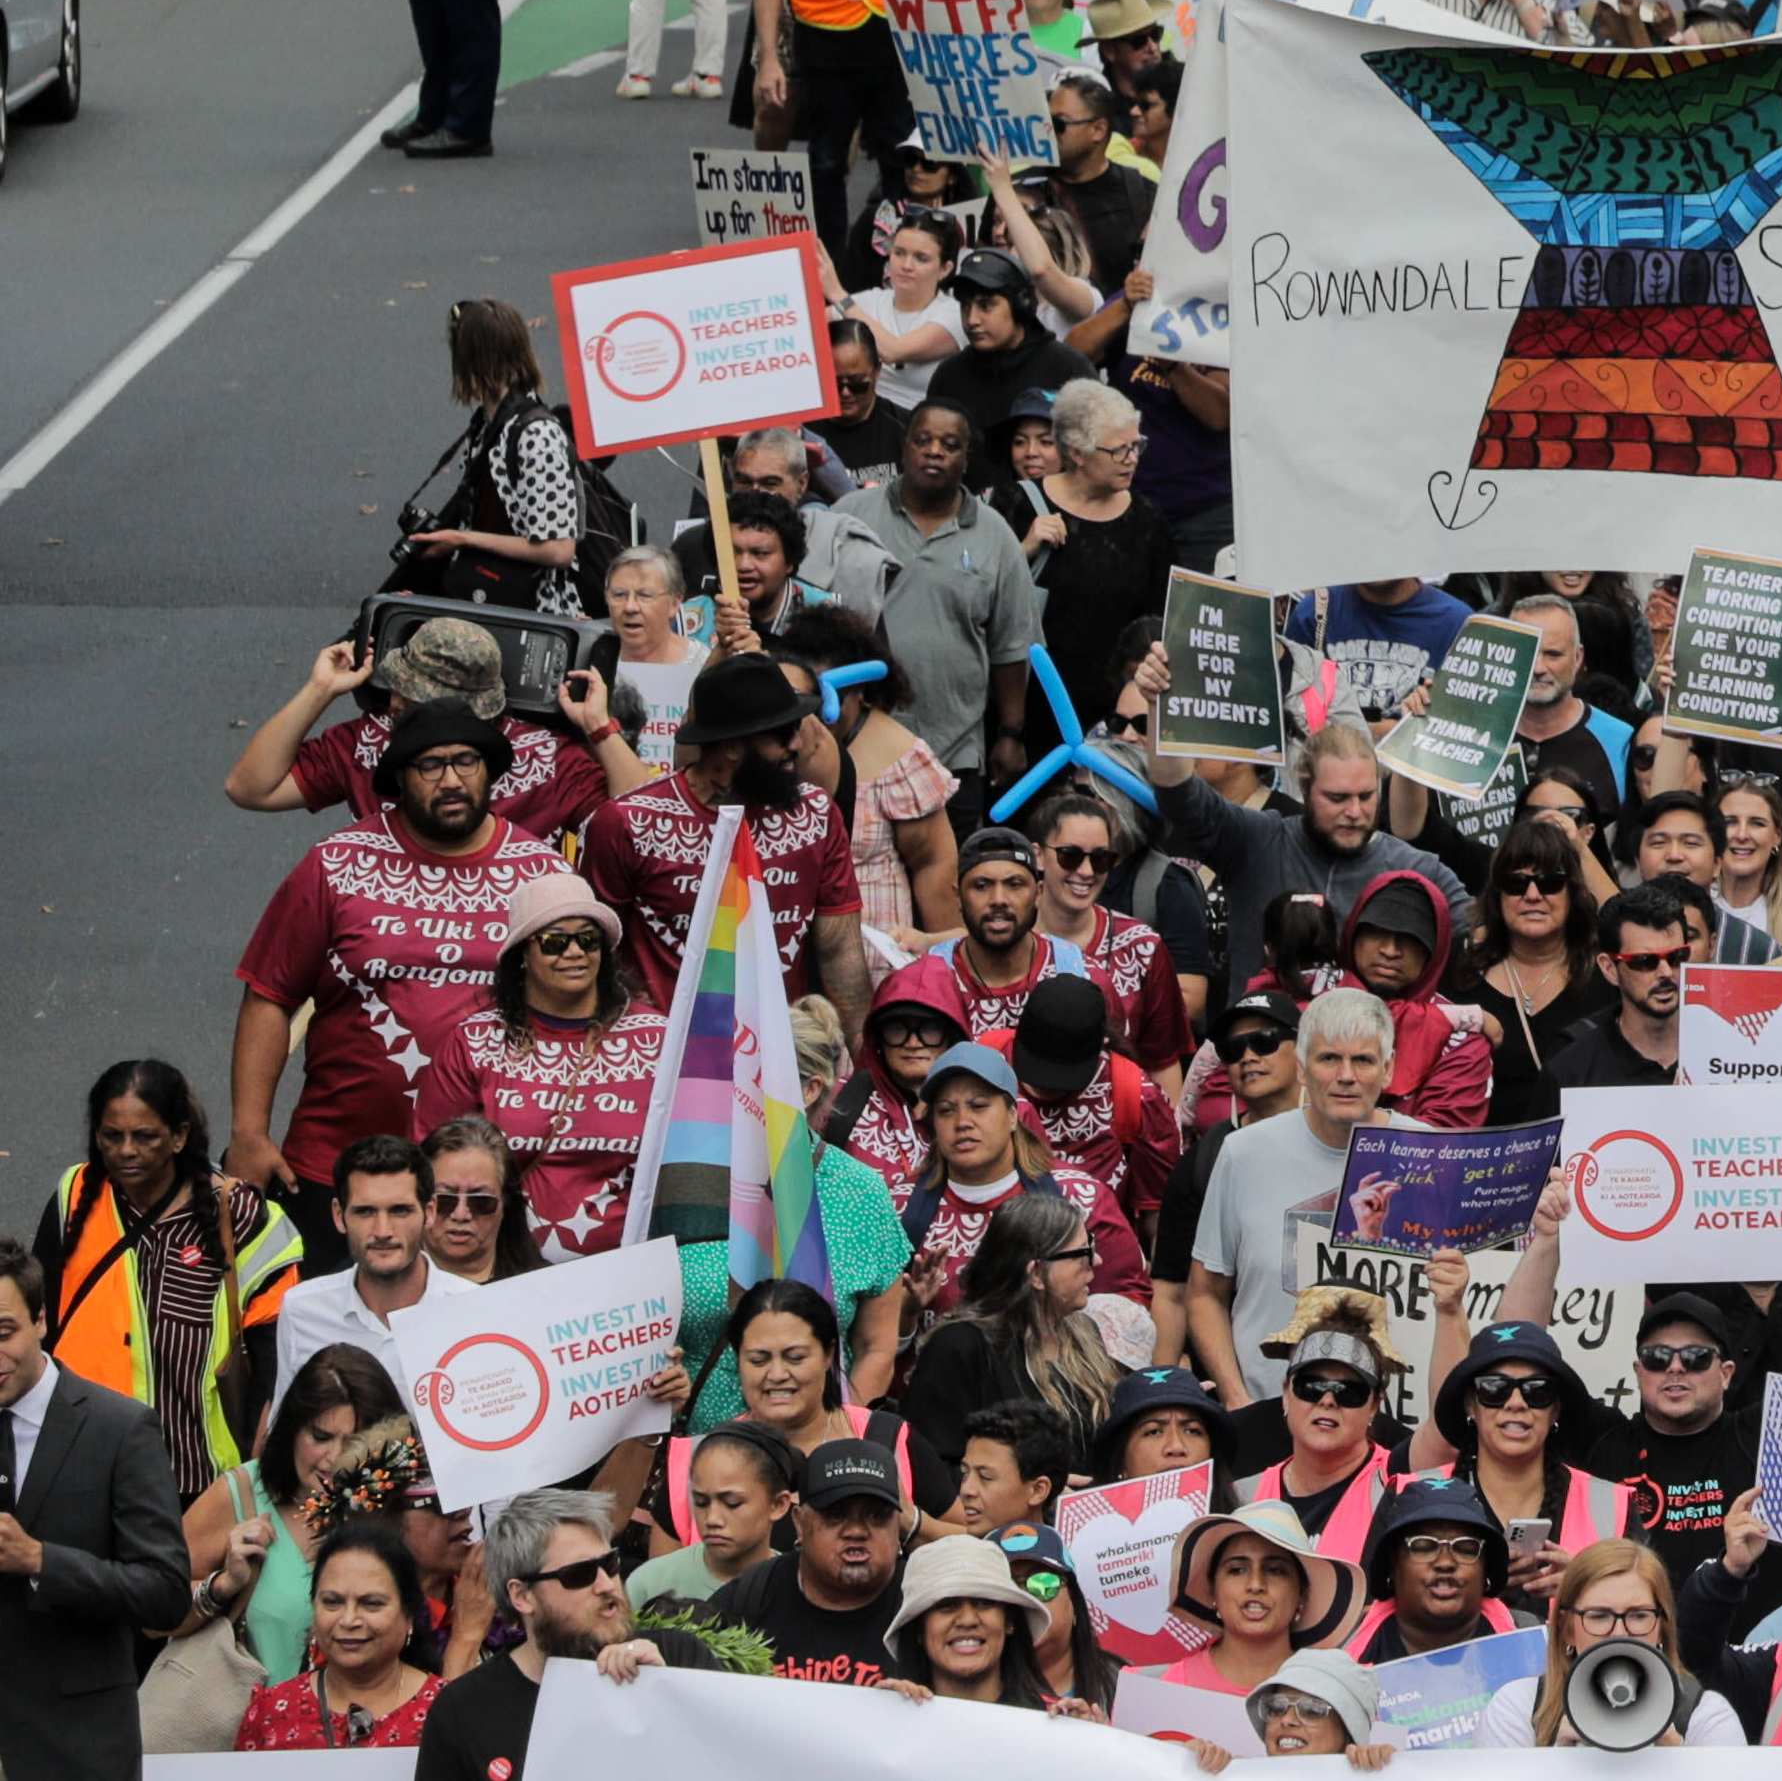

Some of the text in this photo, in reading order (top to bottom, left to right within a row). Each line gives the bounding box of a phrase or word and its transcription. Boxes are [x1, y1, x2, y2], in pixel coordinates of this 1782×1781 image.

[892, 32, 1039, 77] WHERE'S
[922, 76, 1008, 118] THE
[1251, 230, 1526, 329] ROWANDALE
[1705, 588, 1782, 615] WORKING
[1200, 605, 1223, 628] I'M
[1189, 628, 1240, 654] HERE
[1690, 630, 1782, 659] ARE YOUR
[1198, 653, 1235, 675] FOR
[1700, 652, 1767, 678] CHILD'S
[1205, 677, 1232, 698] MY
[1687, 671, 1775, 701] LEARNING
[1168, 698, 1270, 726] STUDENTS
[1677, 691, 1780, 724] CONDITIONS
[1692, 1137, 1781, 1156] INVEST
[1694, 1188, 1782, 1207] INVEST
